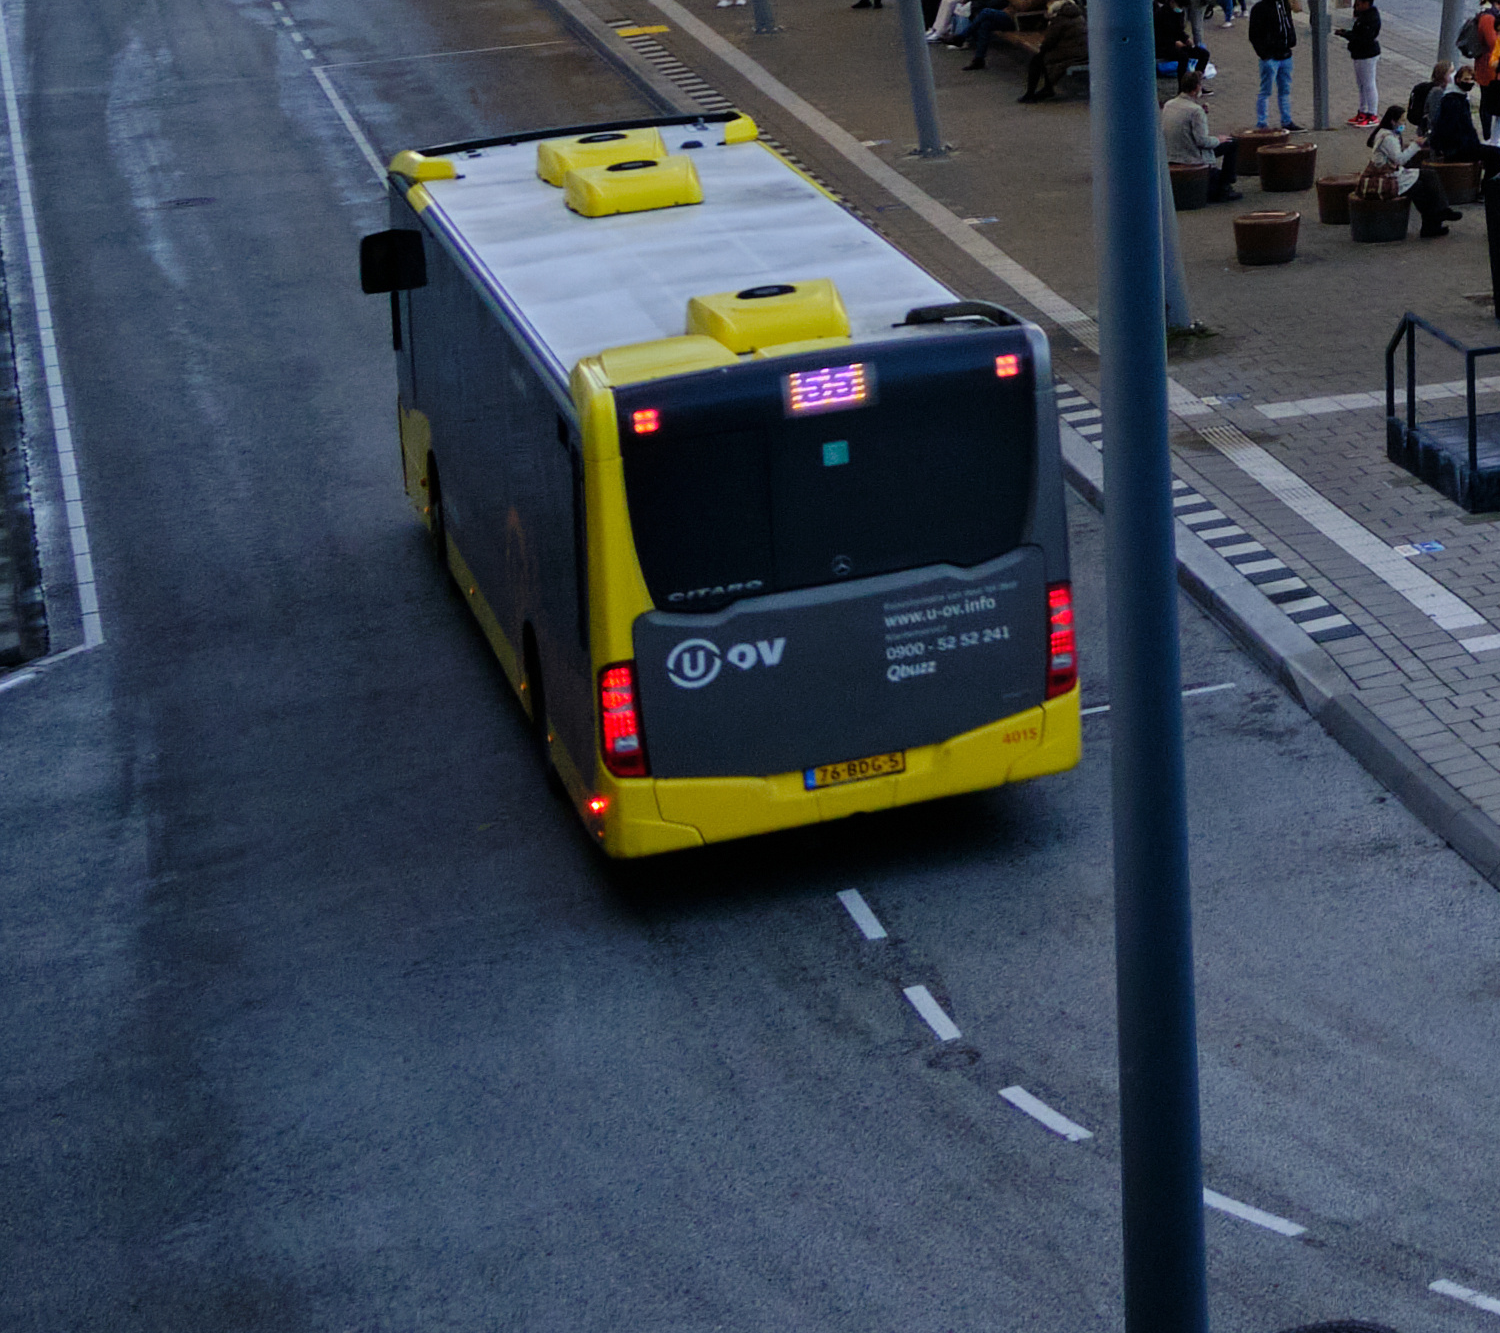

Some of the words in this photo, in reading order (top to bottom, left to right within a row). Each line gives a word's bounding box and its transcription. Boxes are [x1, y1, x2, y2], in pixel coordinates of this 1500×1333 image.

[667, 579, 763, 602] CITARO
[884, 595, 996, 628] www.u-ov.info
[727, 636, 786, 671] OV
[886, 641, 925, 660] 0900
[937, 635, 956, 651] 52
[960, 631, 979, 647] 52
[982, 624, 1010, 642] 241
[886, 660, 937, 682] Qbuzz
[1002, 727, 1038, 745] 4015
